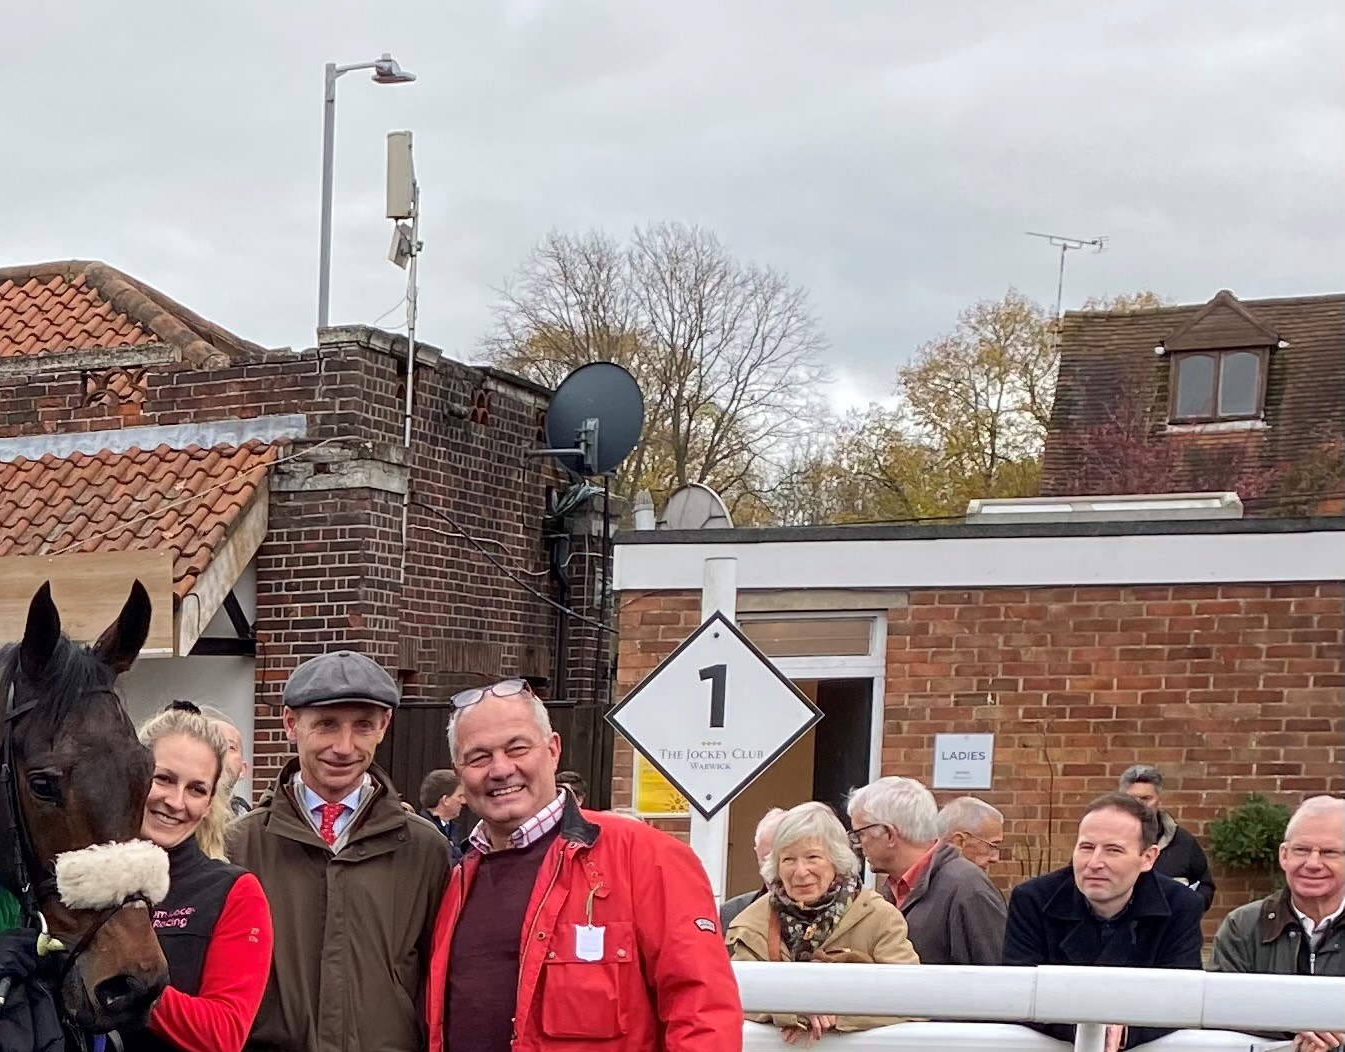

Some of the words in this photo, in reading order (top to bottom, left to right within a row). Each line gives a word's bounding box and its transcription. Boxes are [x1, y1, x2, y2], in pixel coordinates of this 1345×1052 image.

[698, 663, 727, 728] 1
[658, 748, 684, 760] THE
[685, 748, 728, 761] JOCKEY
[731, 748, 764, 760] CLUB
[941, 751, 986, 760] LADIES
